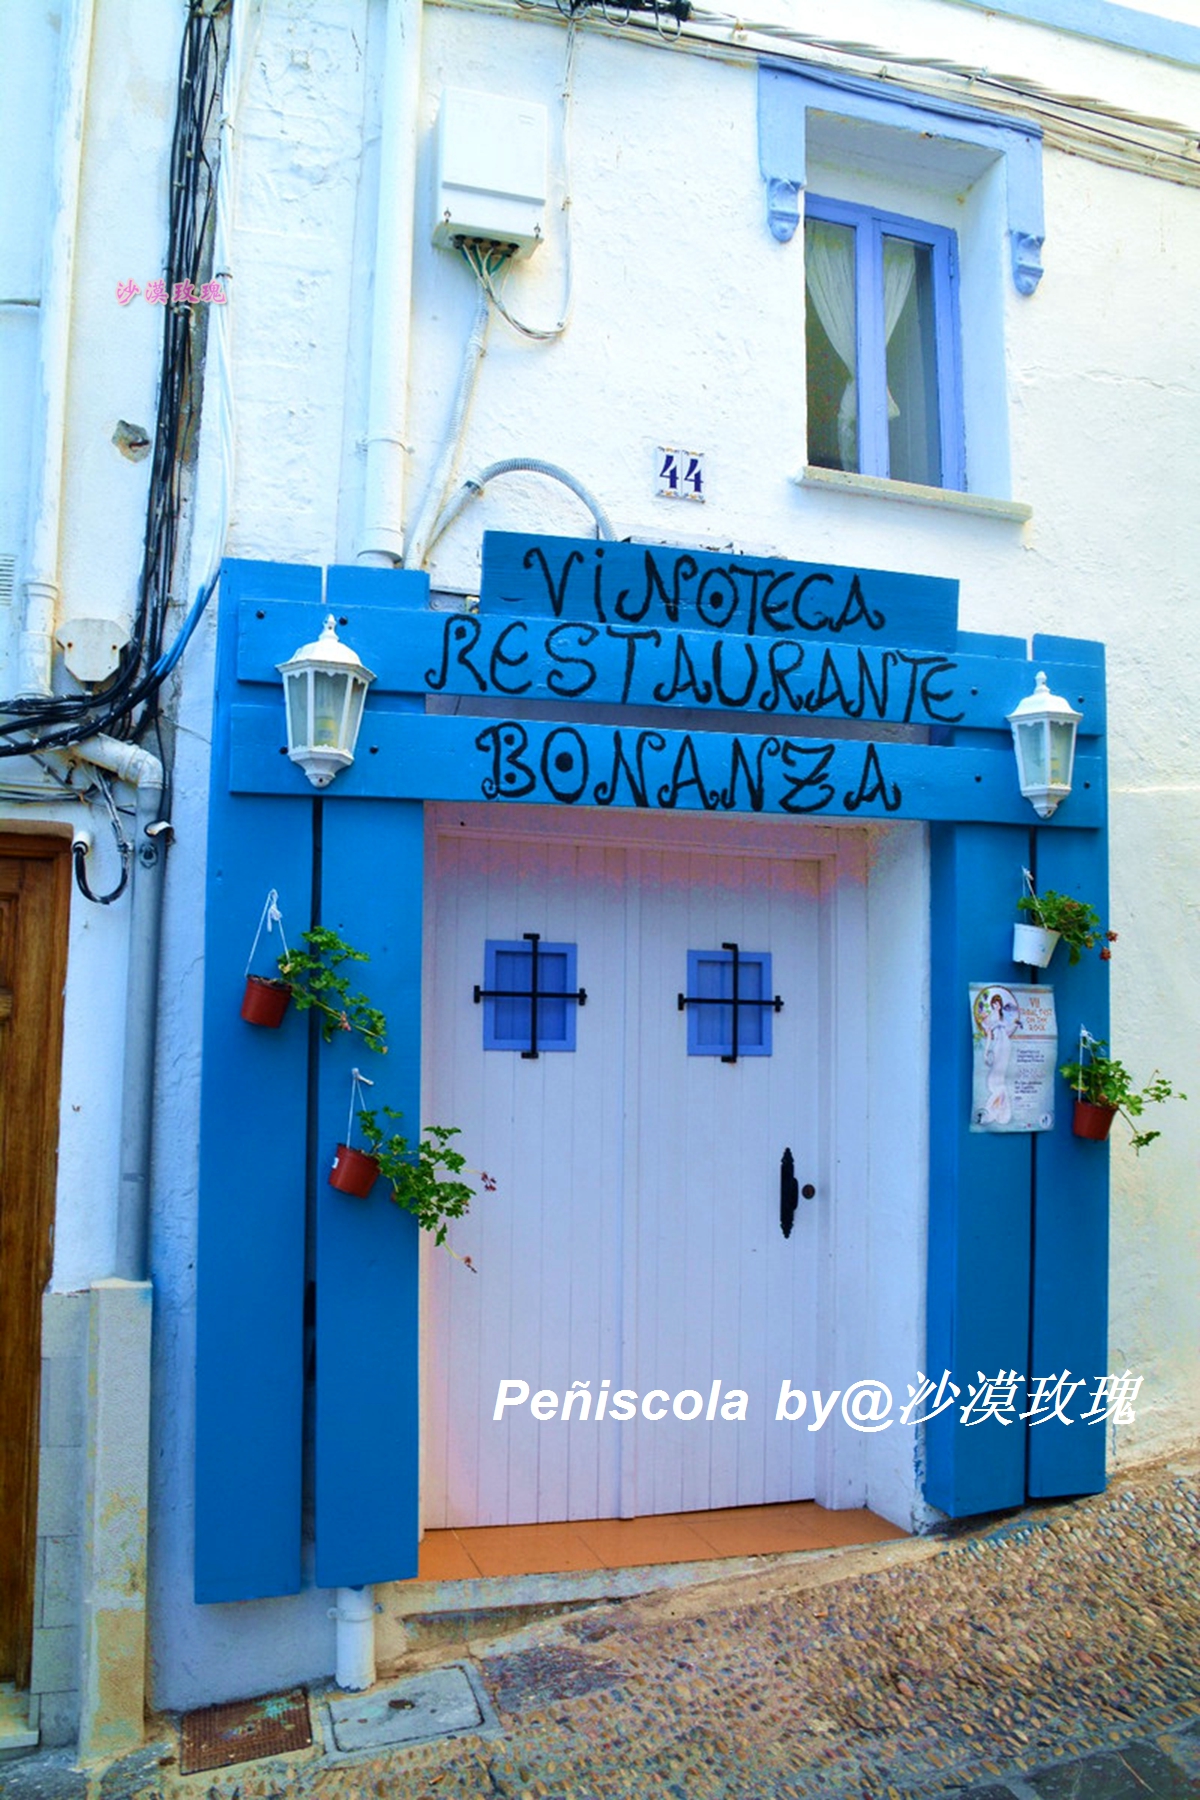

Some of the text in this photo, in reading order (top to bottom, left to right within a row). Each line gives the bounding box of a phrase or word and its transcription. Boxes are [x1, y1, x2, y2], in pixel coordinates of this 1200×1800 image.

[659, 454, 704, 493] 44
[424, 614, 965, 724] RESTAURANTE
[475, 721, 902, 813] BONANZA
